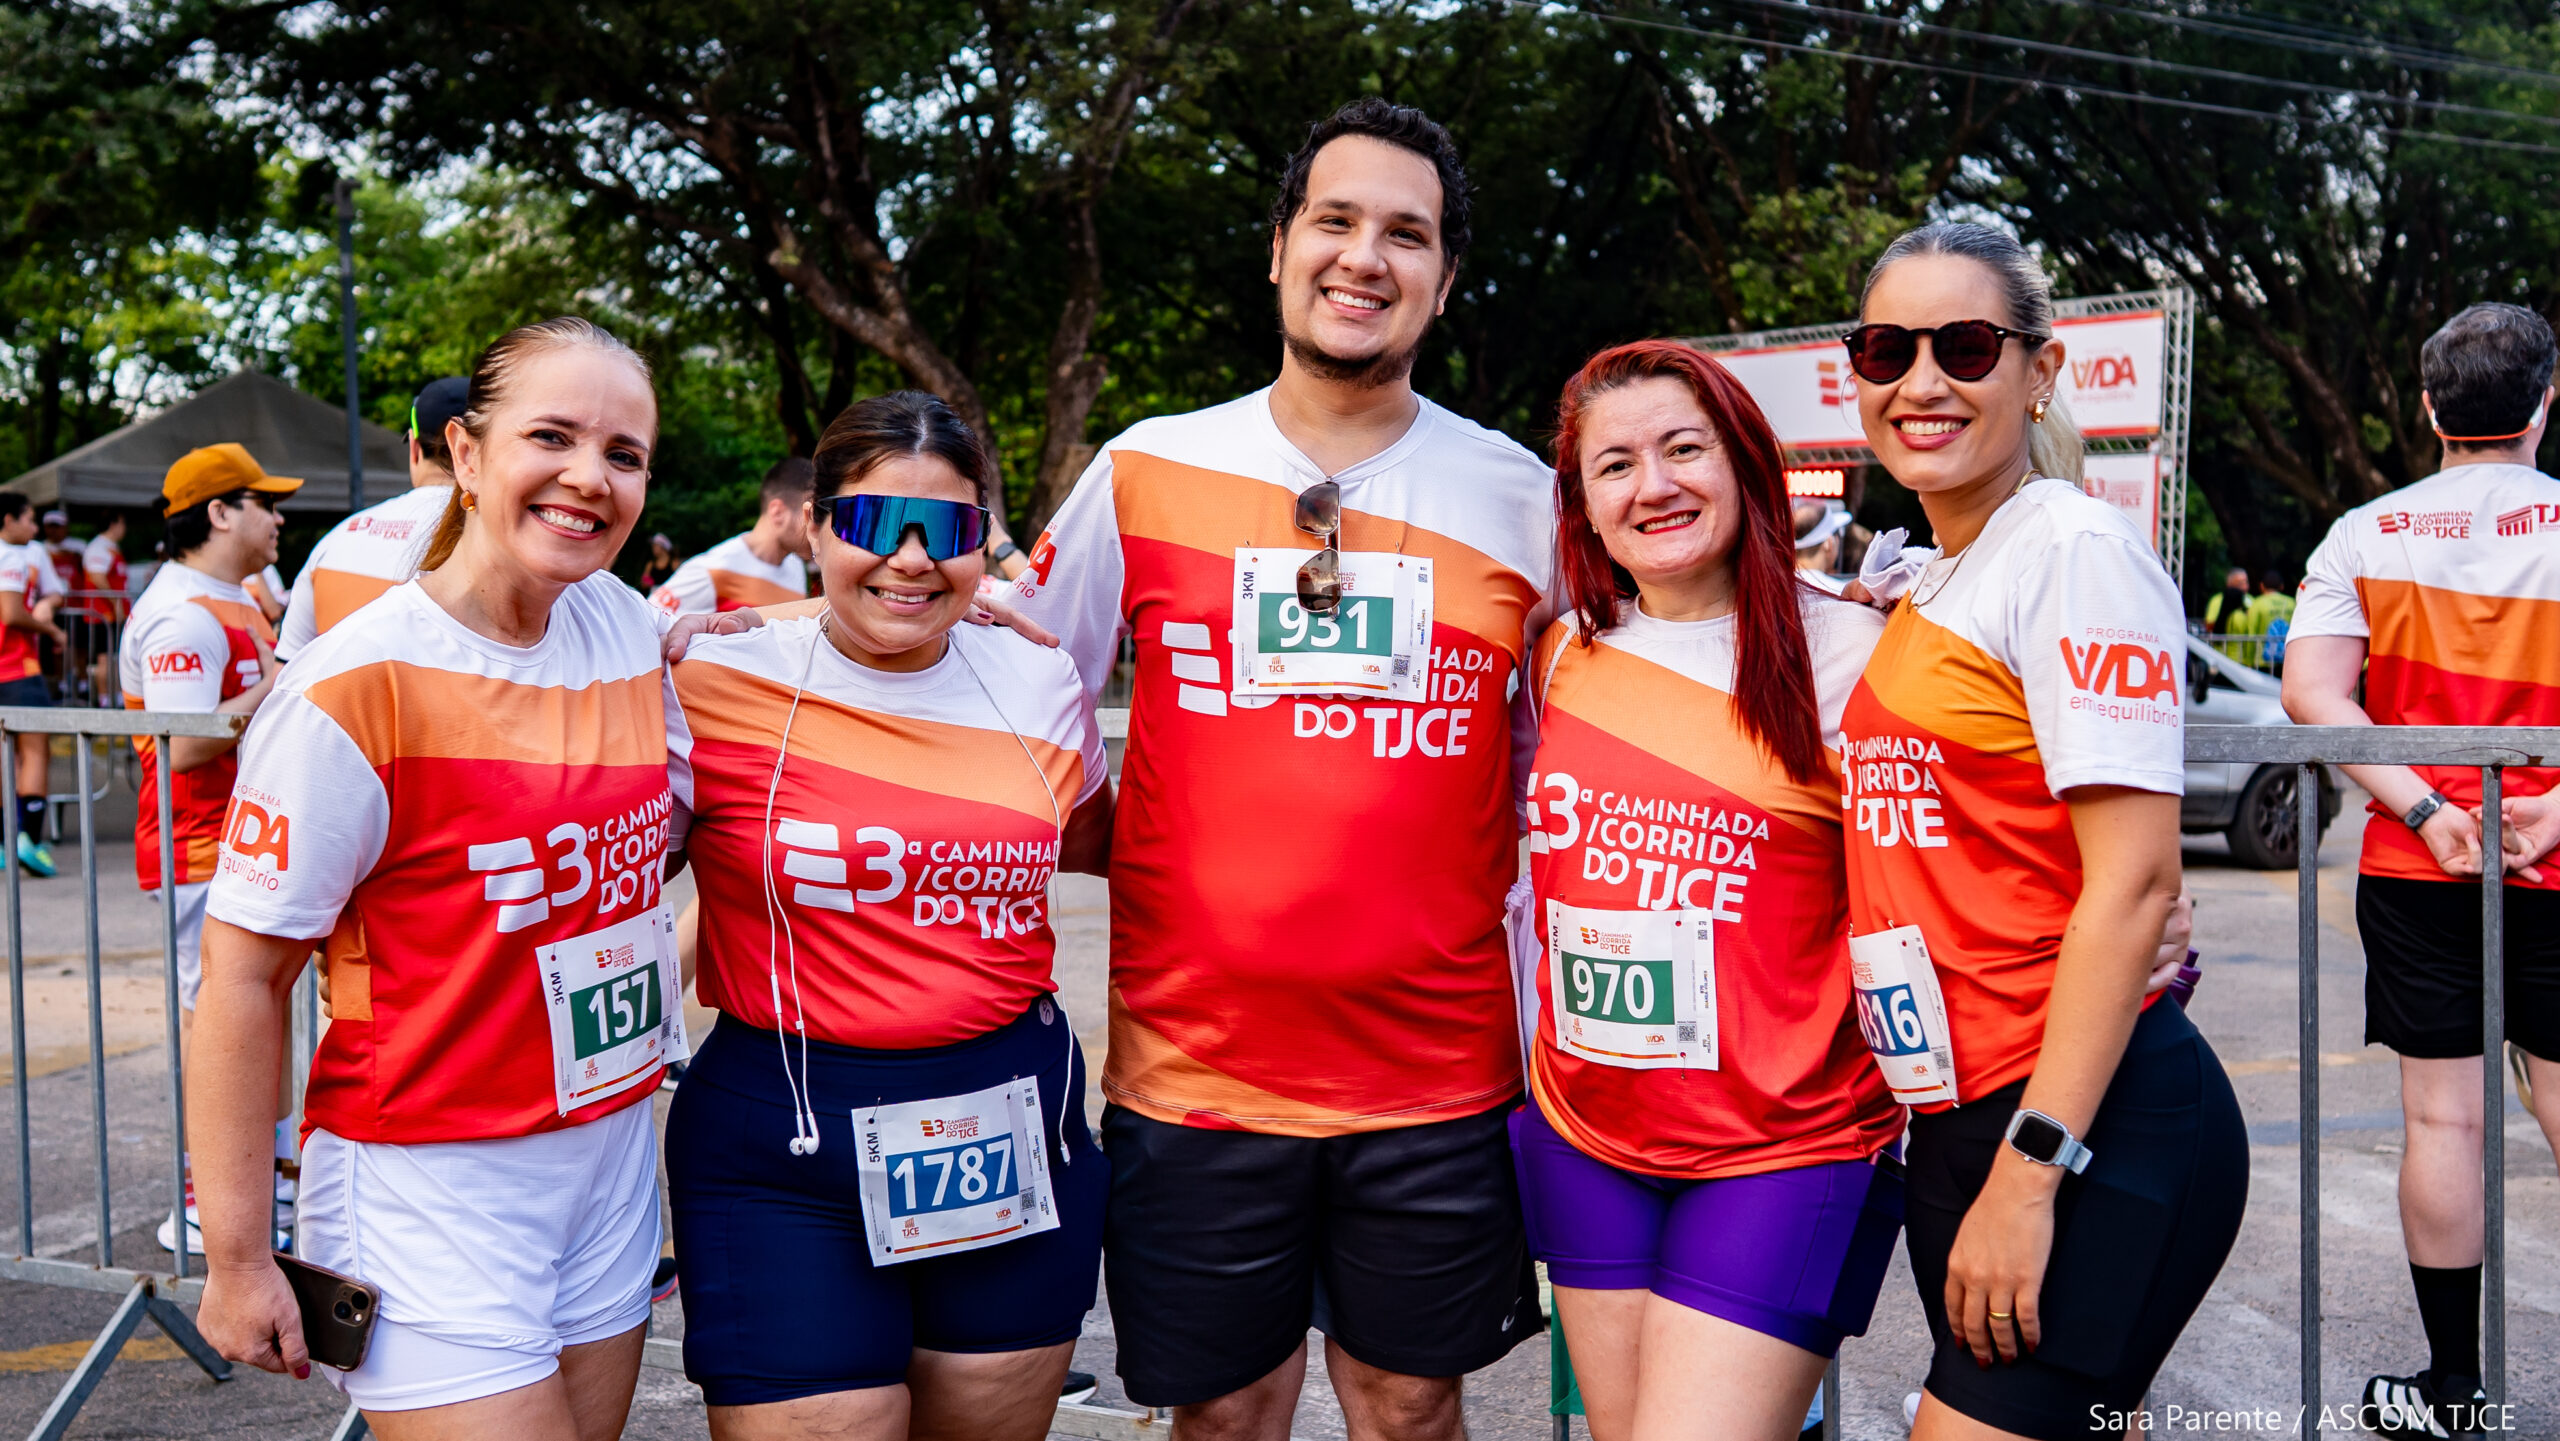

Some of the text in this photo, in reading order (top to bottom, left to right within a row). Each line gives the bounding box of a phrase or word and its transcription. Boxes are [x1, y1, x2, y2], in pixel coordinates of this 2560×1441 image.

[2071, 354, 2137, 389] VIDA
[2433, 526, 2470, 539] TJCE
[2534, 504, 2560, 522] TJ
[1242, 571, 1255, 599] 3KM
[1279, 597, 1369, 648] 931
[2086, 627, 2160, 643] PROGRAMA
[148, 652, 204, 674] VIDA
[1268, 665, 1285, 673] TJCE
[2059, 636, 2179, 707] VIDA
[1294, 703, 1472, 758] DO TJCE
[603, 788, 673, 842] CAMINH
[1599, 791, 1770, 841] CAMINHADA
[599, 818, 669, 880] /CORR
[1586, 814, 1757, 871] /CORRIDA
[598, 870, 638, 914] DO
[914, 864, 1051, 893] /CORRID
[1582, 846, 1748, 923] DO TJCE
[913, 894, 1045, 939] DO TJCE
[1610, 944, 1631, 954] TJCE
[551, 971, 564, 1005] 3KM
[588, 969, 649, 1045] 157
[1572, 959, 1654, 1019] 970
[867, 1132, 880, 1163] 5KM
[958, 1126, 979, 1139] TJCE
[892, 1138, 1012, 1210] 1787
[902, 1226, 920, 1237] TJCE
